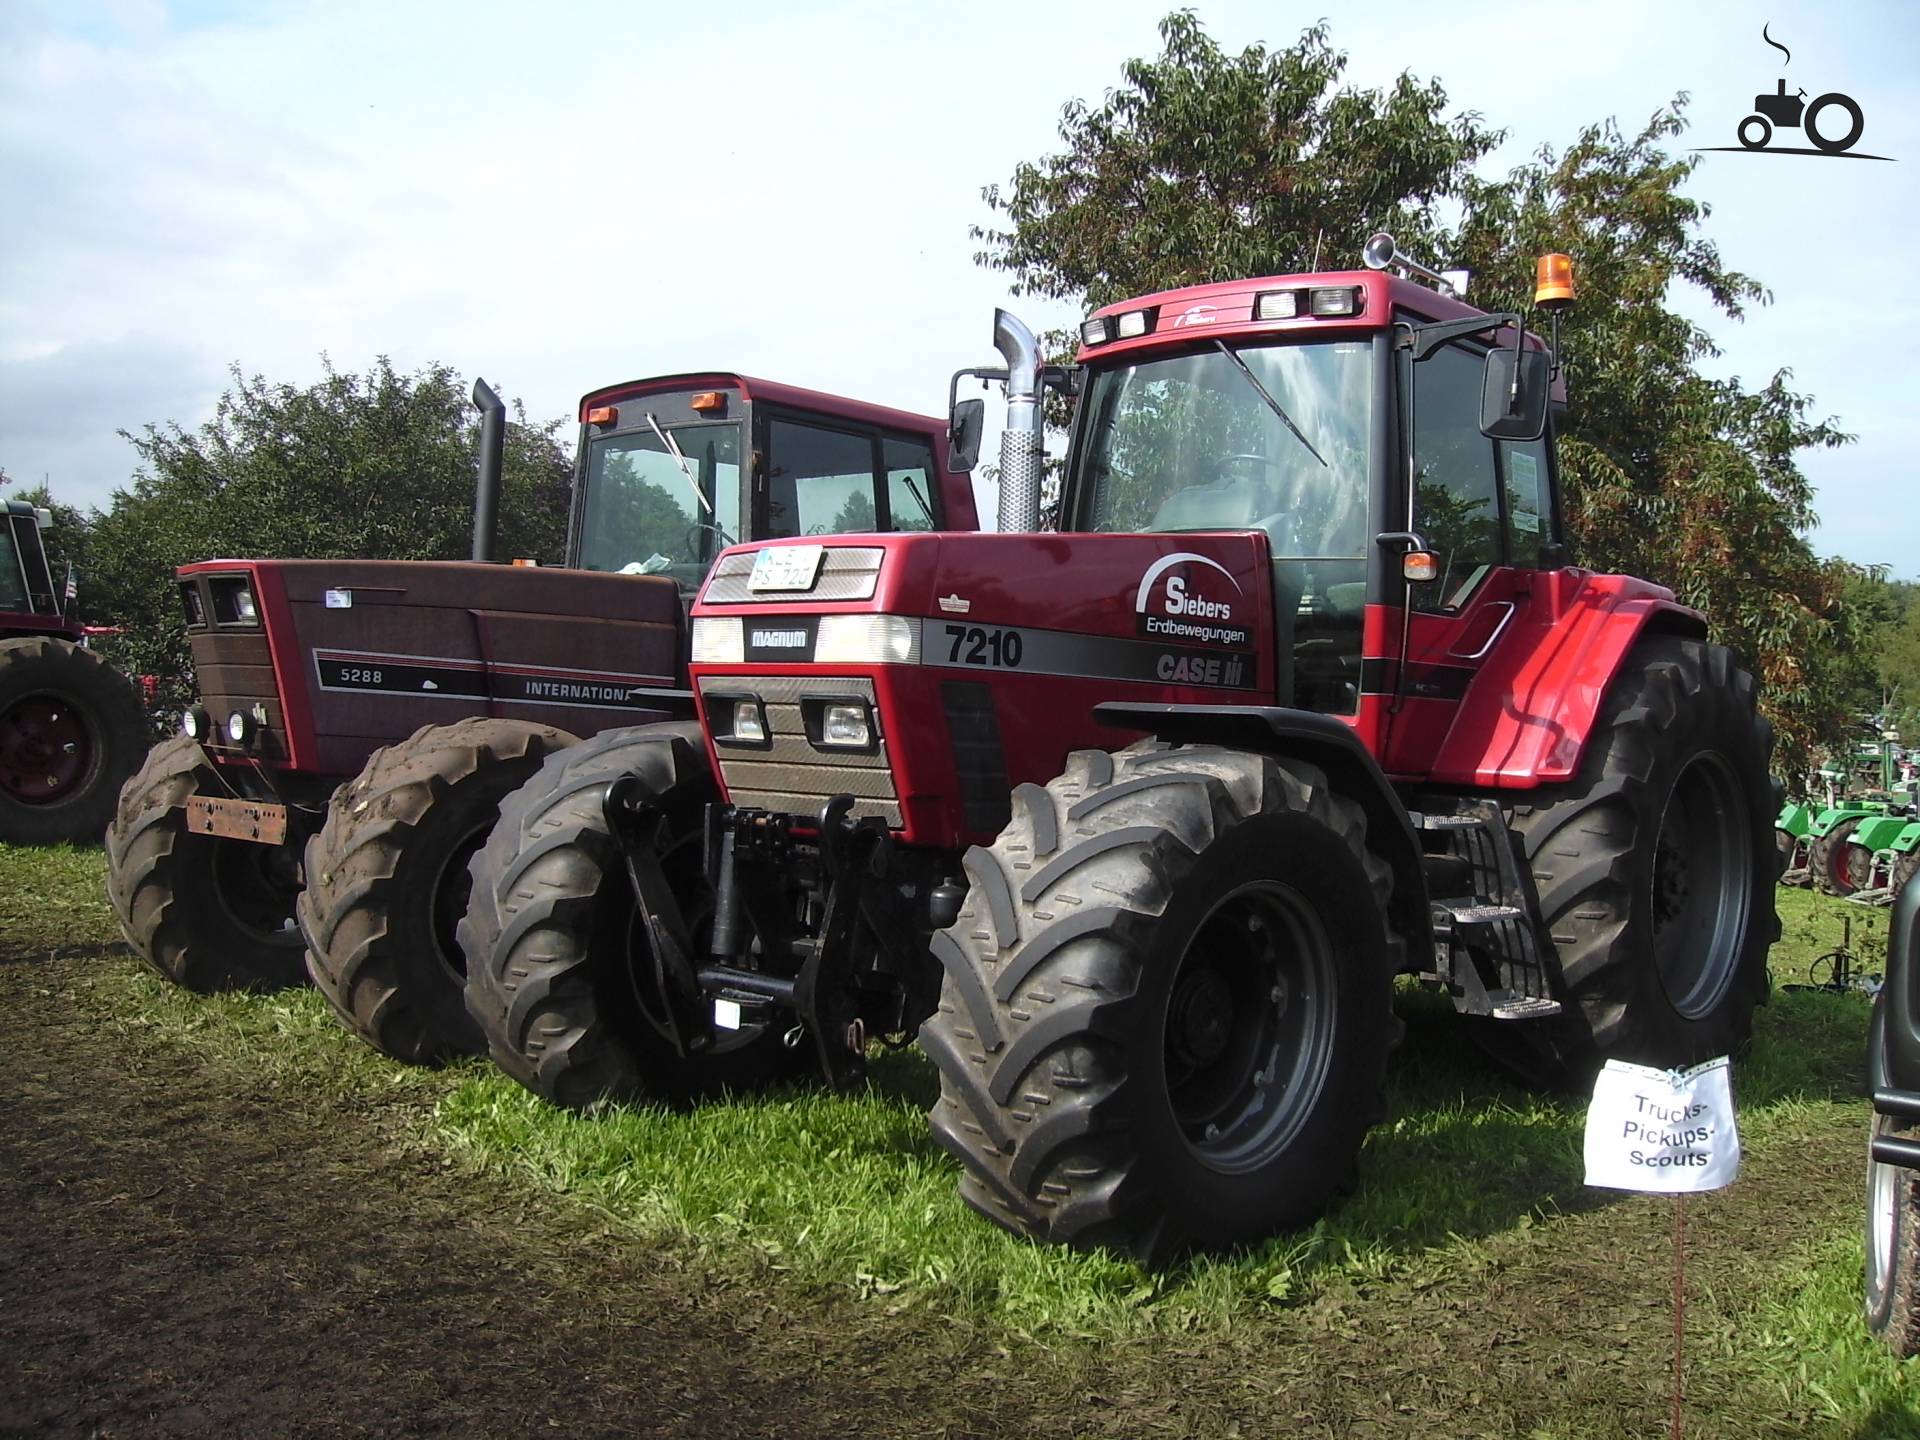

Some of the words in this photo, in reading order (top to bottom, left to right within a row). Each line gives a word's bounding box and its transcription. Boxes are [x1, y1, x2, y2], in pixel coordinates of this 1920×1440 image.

[1165, 576, 1231, 620] Siebers
[752, 631, 806, 648] MAGNUM
[1147, 617, 1245, 644] Erdbewegungen
[946, 624, 1023, 667] 7210
[340, 668, 383, 685] 5288
[1156, 654, 1221, 684] CASE
[526, 681, 633, 702] INTERNATIONA
[1634, 1094, 1709, 1124] Trucks-
[1623, 1120, 1715, 1148] Pickups-
[1629, 1150, 1708, 1168] Scouts
